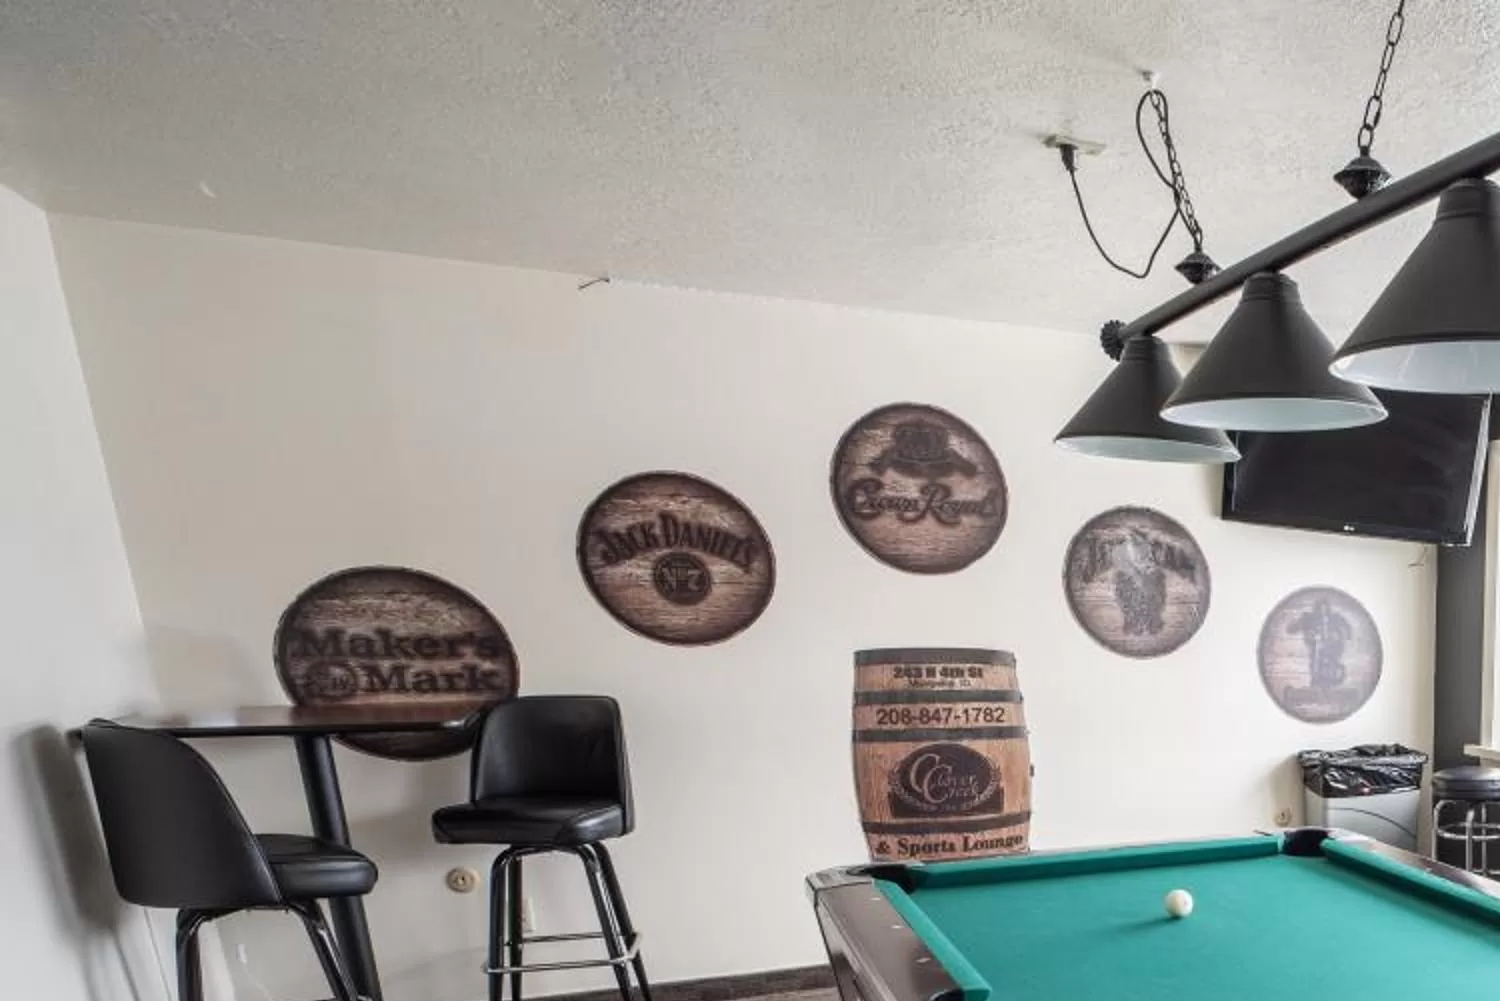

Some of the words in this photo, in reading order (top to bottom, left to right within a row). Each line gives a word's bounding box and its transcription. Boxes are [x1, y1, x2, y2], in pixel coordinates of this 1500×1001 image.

[299, 626, 503, 660] Maker's
[360, 661, 505, 694] Mark
[876, 706, 1006, 726] 208-847-1782
[875, 840, 891, 854] &
[897, 837, 956, 857] Sports
[962, 834, 1023, 853] Lounge
